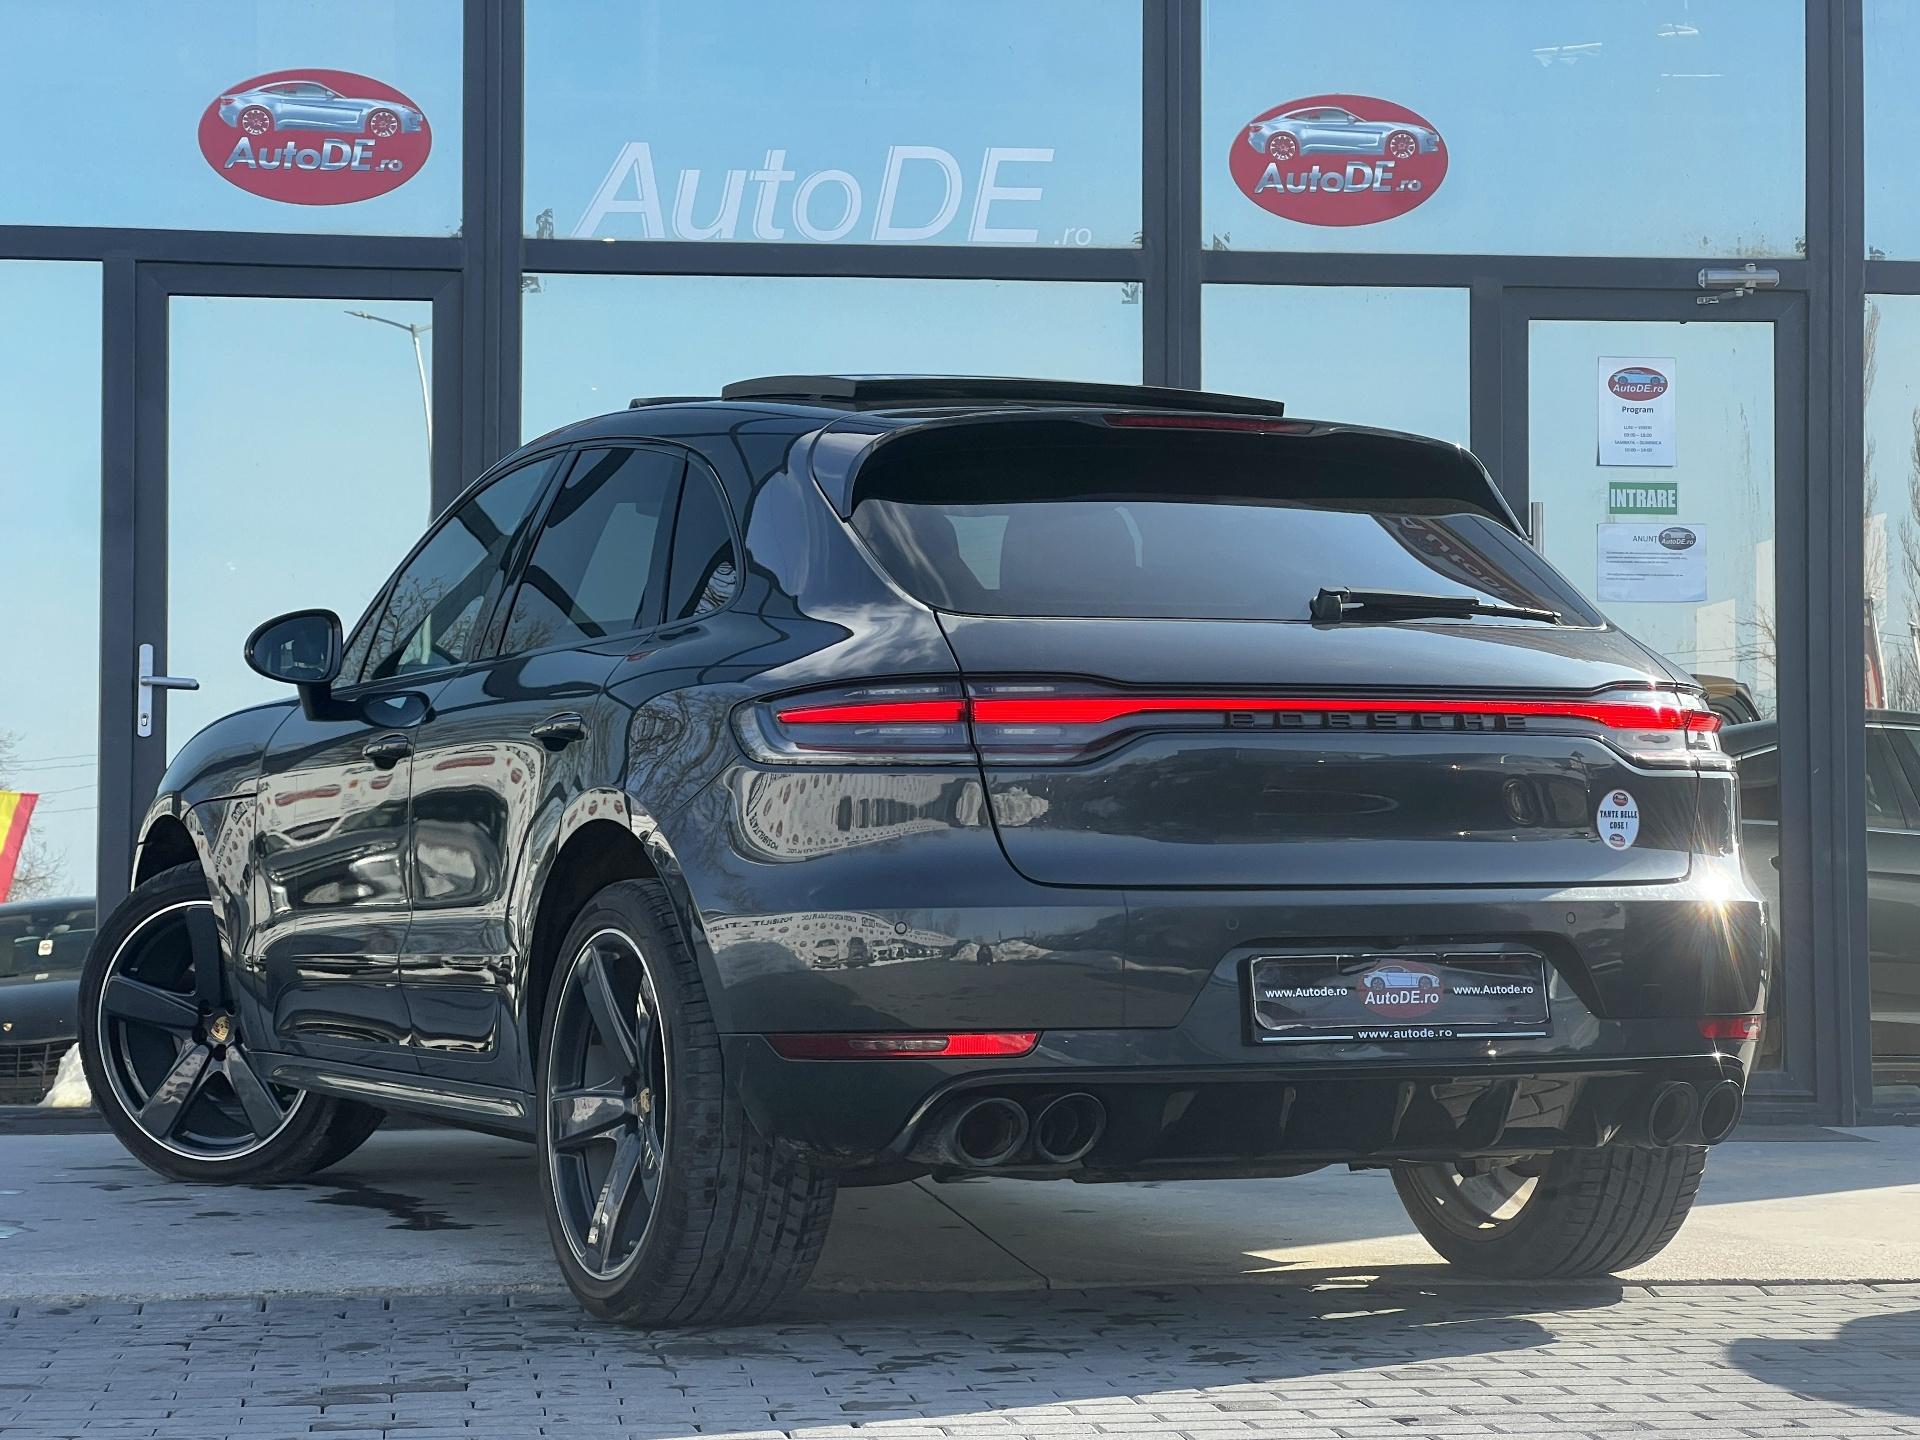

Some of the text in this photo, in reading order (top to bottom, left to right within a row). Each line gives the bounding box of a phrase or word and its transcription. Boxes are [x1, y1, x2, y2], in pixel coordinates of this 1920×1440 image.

[1612, 384, 1664, 394] AutoDE.ro
[1621, 406, 1654, 415] Program
[1610, 488, 1676, 508] INTRARE
[1600, 810, 1637, 818] TANTE BELLE
[1265, 986, 1348, 998] www.Autode.ro
[1453, 985, 1534, 995] www.Autode.ro
[1364, 990, 1440, 1005] AutoDE.ro
[1358, 1028, 1453, 1039] www.autode.ro
